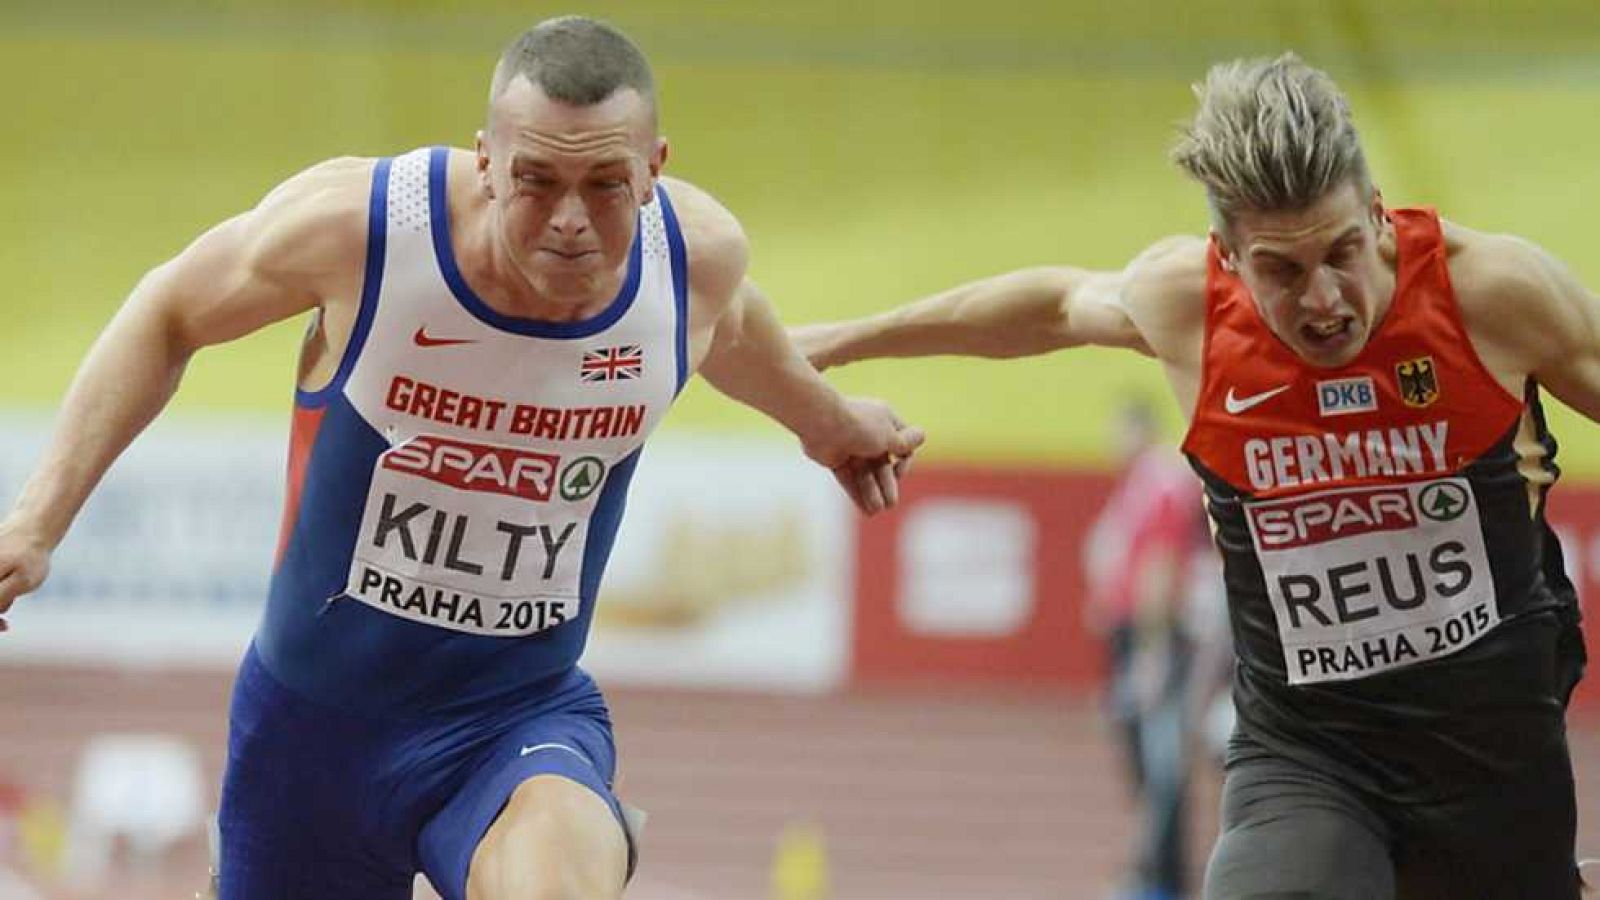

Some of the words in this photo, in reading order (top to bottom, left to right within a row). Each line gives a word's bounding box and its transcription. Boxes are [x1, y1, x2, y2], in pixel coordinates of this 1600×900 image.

[386, 376, 506, 430] GREAT
[509, 404, 646, 440] BRITAIN
[1321, 383, 1372, 408] DKB
[388, 441, 552, 495] SPAR
[1243, 421, 1449, 490] GERMANY
[373, 493, 577, 581] KILTY
[1256, 494, 1412, 545] SPAR
[359, 567, 484, 628] PRAHA
[495, 601, 565, 630] 2015
[1278, 541, 1473, 628] REUS
[1298, 634, 1418, 676] PRAHA
[1424, 604, 1490, 653] 2015
